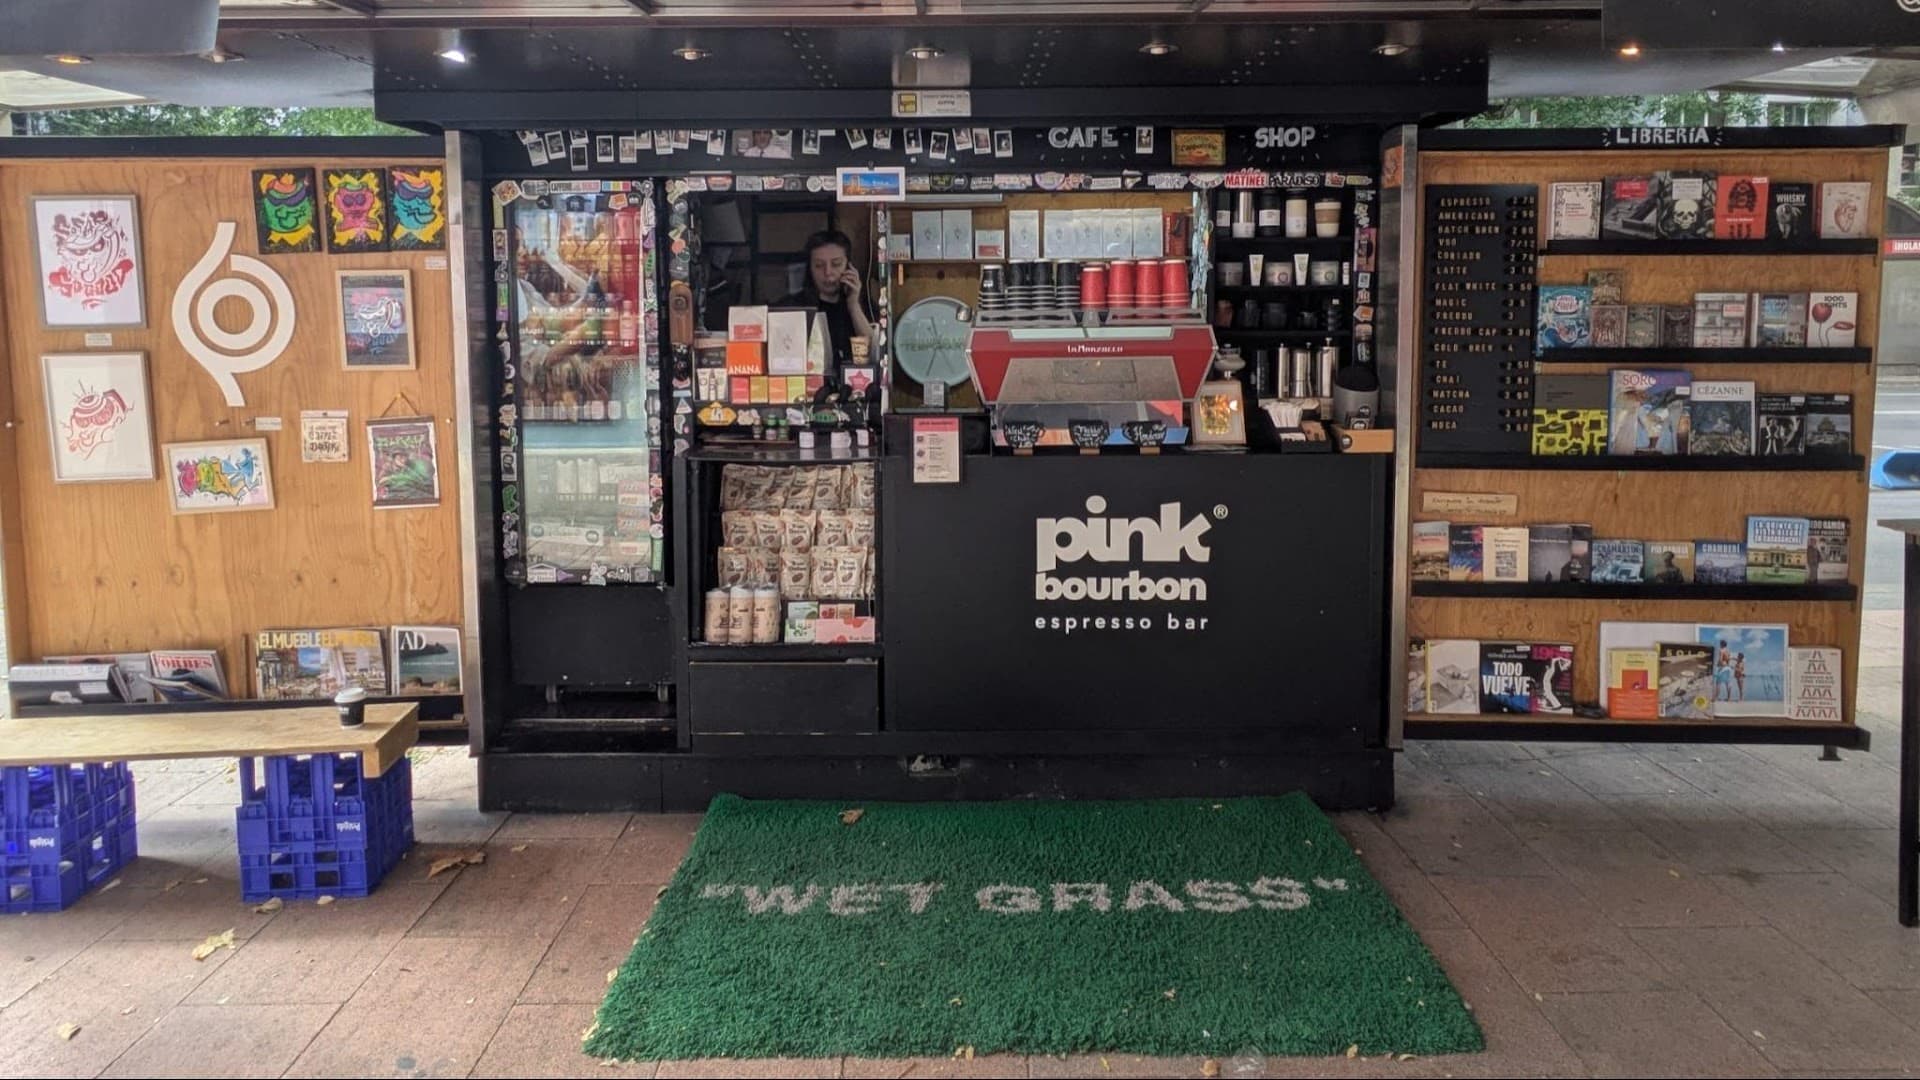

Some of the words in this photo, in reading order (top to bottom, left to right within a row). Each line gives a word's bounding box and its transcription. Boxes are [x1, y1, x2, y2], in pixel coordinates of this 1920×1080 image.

[1254, 126, 1316, 149] SHOP
[1440, 197, 1491, 207] ESPRESSO
[1776, 194, 1806, 204] WHISKY
[1438, 211, 1496, 220] AMERICANO
[1437, 225, 1470, 235] BATCH
[1436, 266, 1468, 275] LATTE
[1435, 282, 1459, 291] FLAT
[1465, 282, 1496, 291] WHITE
[1435, 298, 1467, 307] MAGIC
[1433, 343, 1459, 352] COLD
[1436, 375, 1460, 384] CHAI
[1432, 390, 1471, 399] MATCHA
[1697, 384, 1745, 396] CÉZANNE
[1433, 405, 1465, 414] CACAO
[1036, 495, 1212, 573] pink
[1035, 570, 1207, 601] bourbon
[1035, 616, 1152, 634] espresso
[1167, 612, 1209, 630] bar
[273, 631, 321, 649] MUEBLE
[400, 631, 427, 650] AD
[1492, 661, 1523, 676] TODO
[1482, 675, 1531, 696] VUELVE
